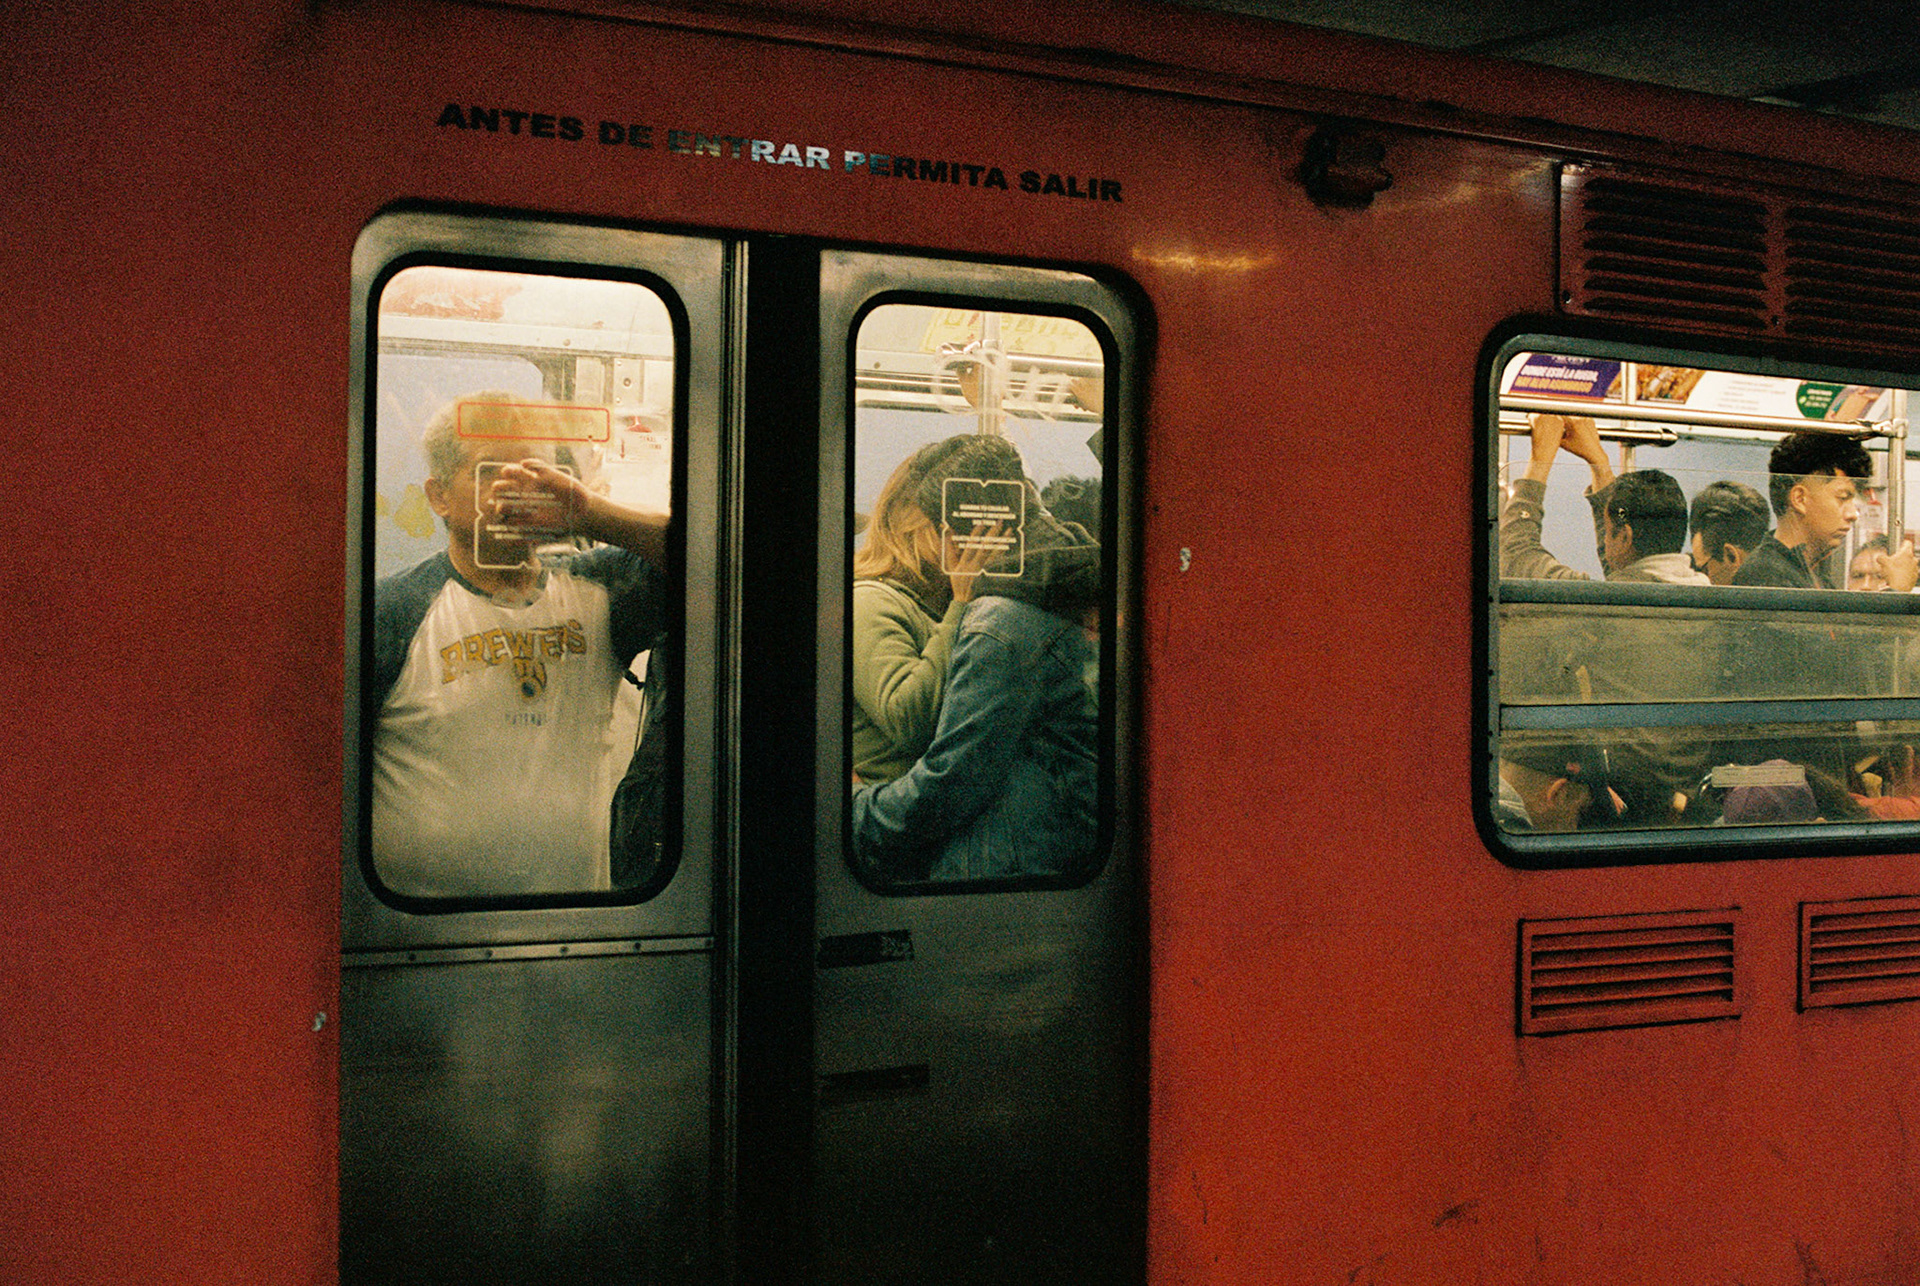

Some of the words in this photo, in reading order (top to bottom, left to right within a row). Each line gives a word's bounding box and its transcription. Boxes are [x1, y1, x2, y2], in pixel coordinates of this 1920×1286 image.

[436, 103, 583, 142] ANTES
[597, 119, 654, 150] DE
[668, 129, 831, 170] ENTRAR
[844, 150, 1009, 190] PERMITA
[1019, 170, 1123, 203] SALIR
